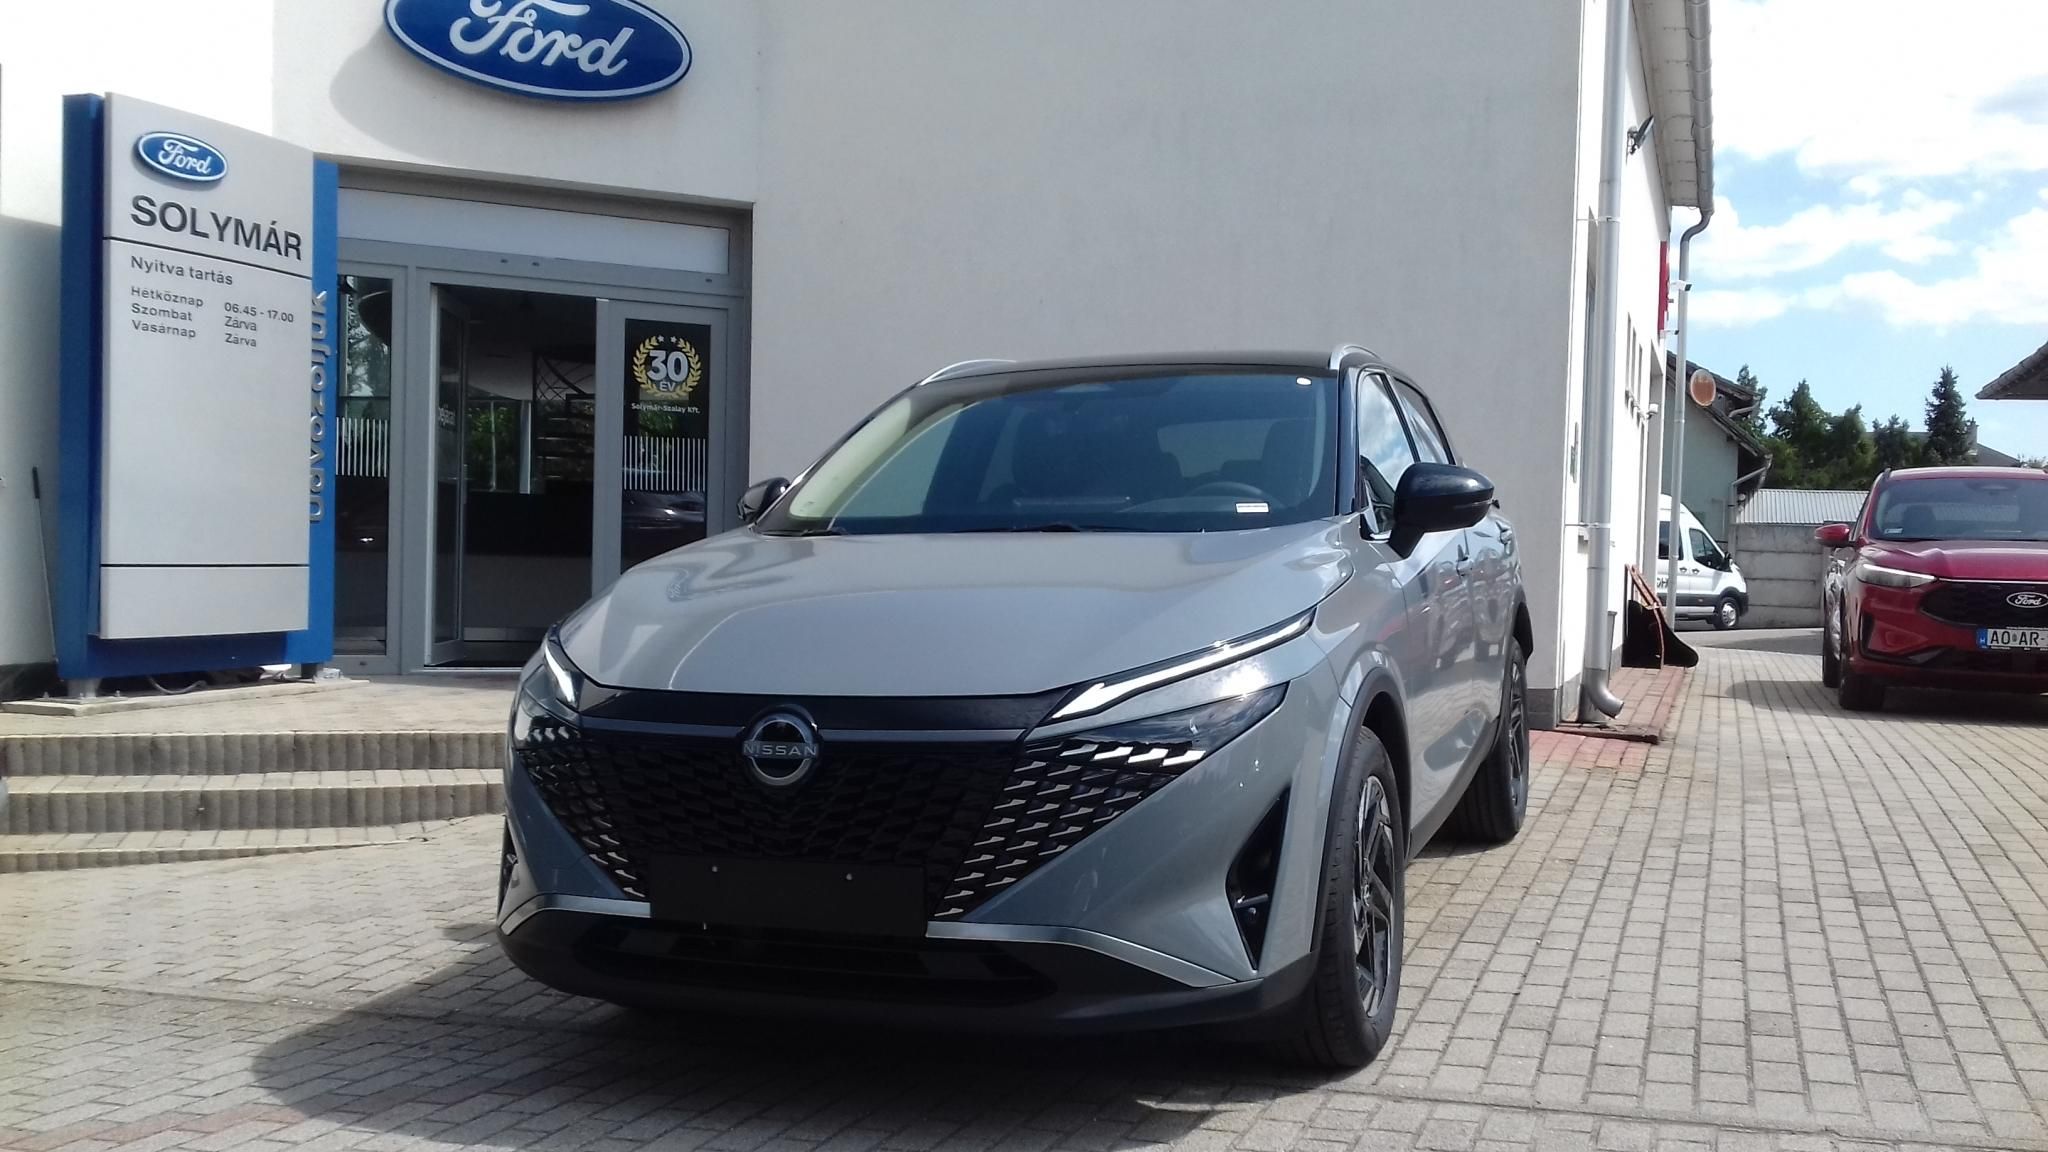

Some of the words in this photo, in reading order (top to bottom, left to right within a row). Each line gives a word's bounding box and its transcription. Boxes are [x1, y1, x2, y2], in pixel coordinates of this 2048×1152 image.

[449, 0, 635, 76] Ford
[159, 140, 212, 174] Ford
[130, 195, 302, 260] SOLYMÁR
[131, 255, 185, 273] Nyitva
[189, 268, 233, 285] tartás
[131, 303, 193, 321] Szombat
[224, 315, 257, 331] Zárva
[224, 302, 257, 316] 06.45
[267, 309, 295, 322] 17.00
[131, 319, 197, 338] Vasárnap
[224, 333, 257, 347] Zárva
[647, 350, 688, 382] 30
[2014, 594, 2042, 605] Ford
[743, 743, 817, 755] NISSAN
